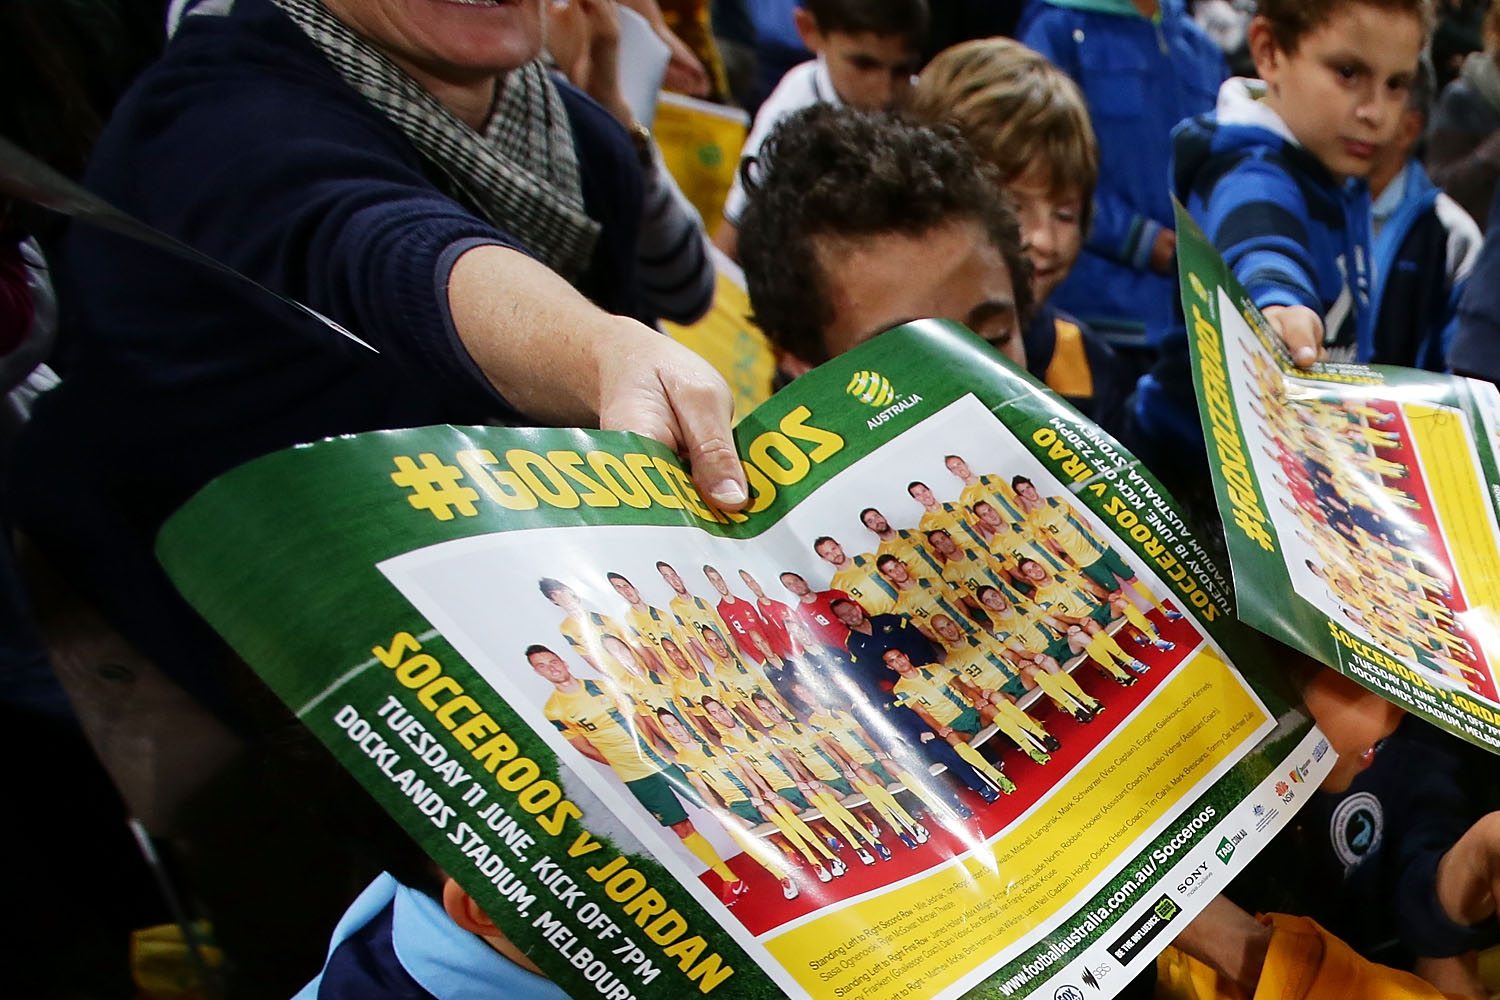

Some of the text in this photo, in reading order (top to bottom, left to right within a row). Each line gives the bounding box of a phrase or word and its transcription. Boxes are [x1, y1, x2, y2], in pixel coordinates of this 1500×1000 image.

[866, 393, 923, 431] AUSTRALIA
[1048, 417, 1095, 458] 7.30PM
[391, 405, 846, 523] #GOSOCCEOOS
[1032, 428, 1094, 483] IRAQ
[1091, 456, 1117, 481] OFF
[1076, 422, 1232, 596] STADIUM AUSTRALIA, SYDNEY
[1114, 479, 1145, 510] KICK
[1102, 496, 1221, 621] SOCCEROOS
[1174, 544, 1190, 559] 18
[1187, 558, 1232, 616] TUESDAY
[1328, 621, 1435, 694] SOCCEROOS
[1348, 662, 1416, 705] DOCKLANDS
[1352, 653, 1404, 688] TUESDAY
[1402, 681, 1412, 692] 11
[1443, 701, 1467, 721] KICK
[1466, 714, 1485, 729] OFF
[334, 705, 457, 829] DOCKLANDS
[447, 822, 537, 917] STADIUM,
[373, 632, 583, 836] SOCCEROOS
[586, 856, 734, 993] JORDAN
[377, 695, 661, 985] TUESDAY 11 JUNE, KICK OFF 7PM
[1217, 844, 1233, 859] TAB
[809, 946, 847, 970] Standing
[842, 936, 860, 950] Left
[856, 933, 867, 942] to
[863, 925, 883, 938] Right
[1058, 801, 1075, 816] Mark
[834, 972, 872, 998] Standing
[867, 963, 885, 977] Left
[881, 959, 891, 968] to
[887, 949, 907, 963] Right
[1060, 831, 1083, 850] Robbie
[1080, 813, 1102, 833] Hooker
[900, 988, 910, 997] to
[907, 977, 925, 991] Right
[1170, 772, 1185, 785] Mark
[999, 806, 1216, 996] www.footballaustralia.com.au/Socceroos
[1177, 861, 1209, 895] SONY
[1114, 914, 1160, 960] BE THE INFLUENCE
[820, 966, 841, 982] Sasa
[864, 975, 892, 996] Franken
[1093, 962, 1111, 980] SBS
